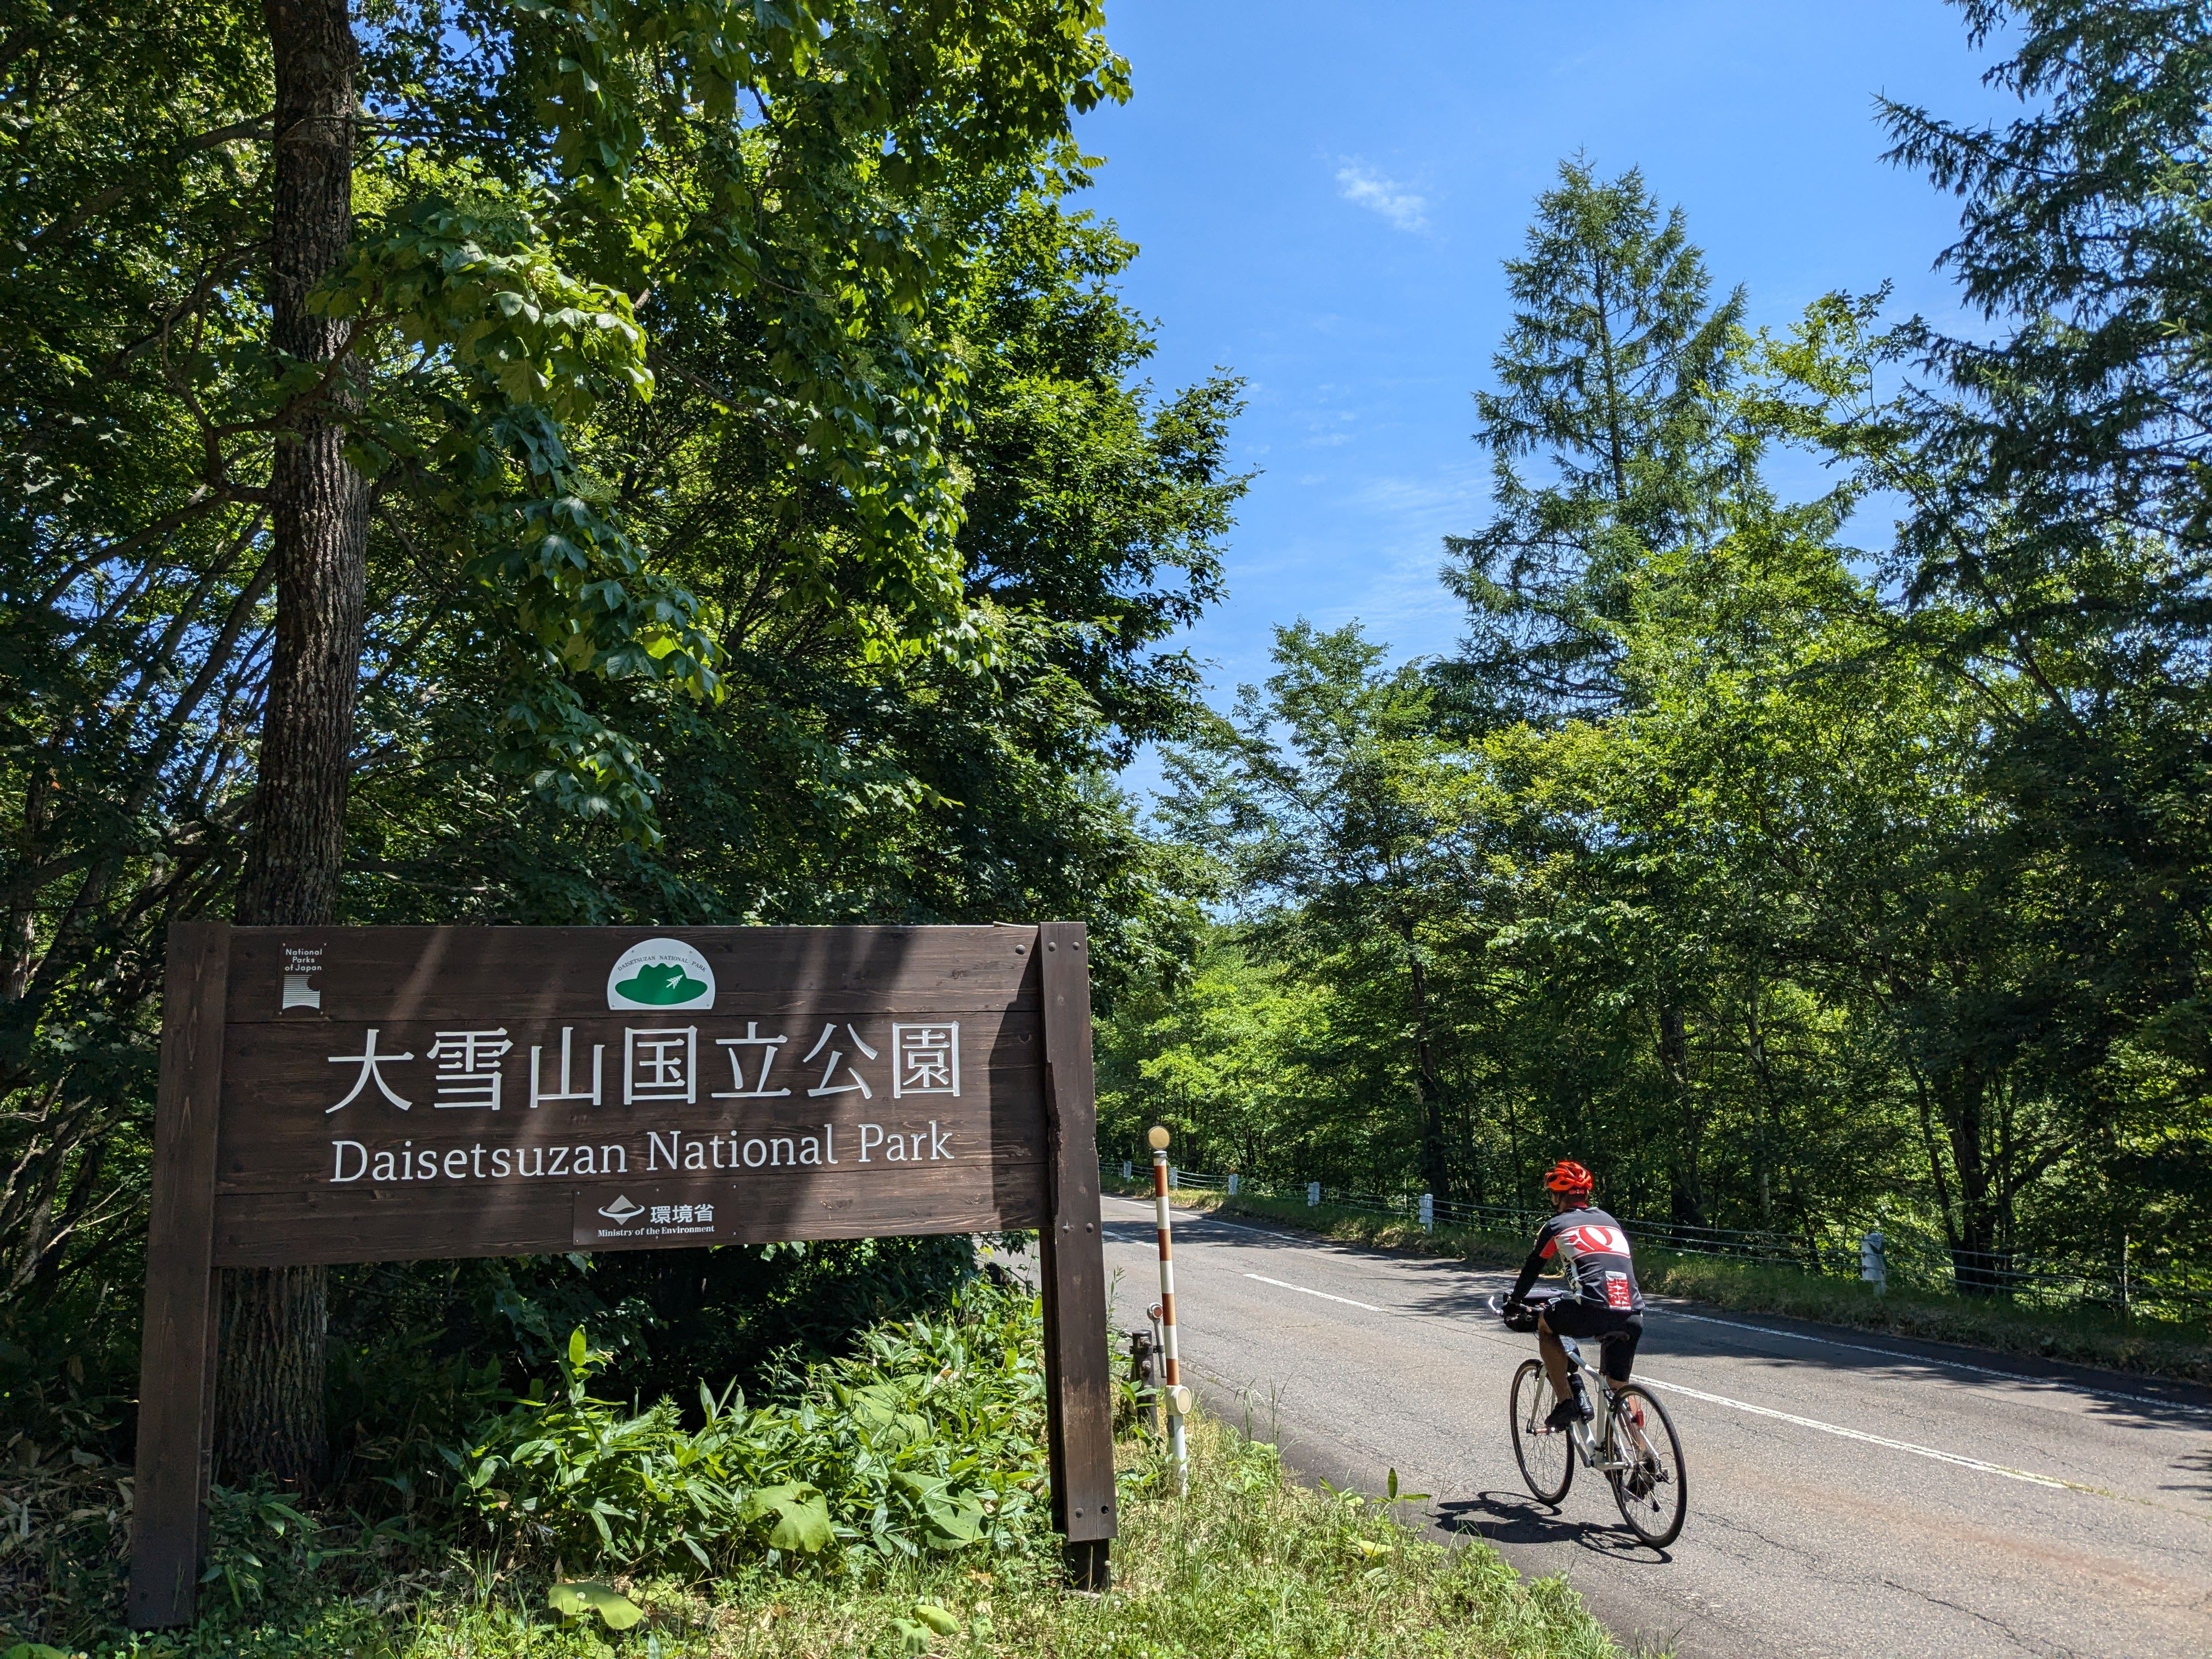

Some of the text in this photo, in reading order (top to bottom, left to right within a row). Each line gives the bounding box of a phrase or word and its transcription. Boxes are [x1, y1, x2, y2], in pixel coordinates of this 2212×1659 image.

[295, 964, 322, 972] Japan
[618, 955, 707, 972] DAISETSUZAN NATIONAL PARK
[325, 1020, 961, 1114] 大雪山国立公園
[330, 1120, 955, 1182] Daisetsuzan National Park
[650, 1204, 714, 1224] 環境省
[598, 1229, 633, 1237] Ministry
[662, 1225, 715, 1234] Environment
